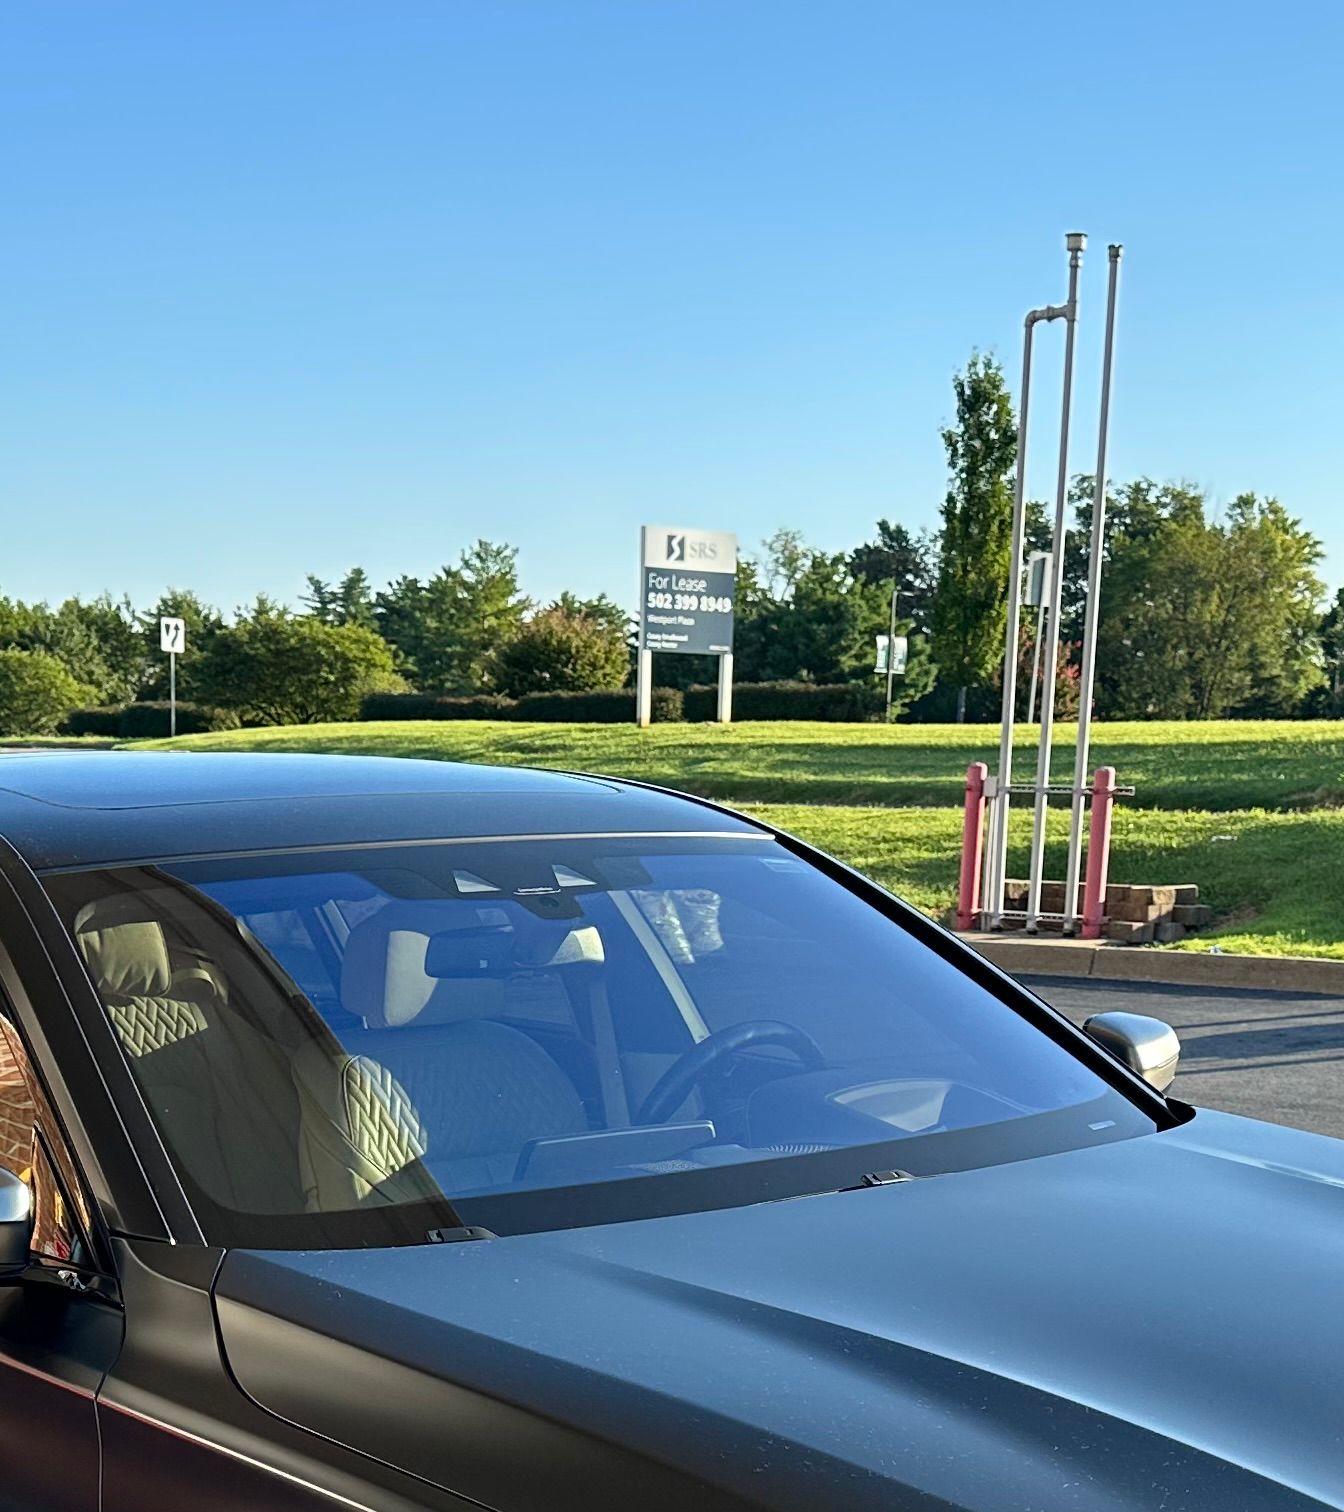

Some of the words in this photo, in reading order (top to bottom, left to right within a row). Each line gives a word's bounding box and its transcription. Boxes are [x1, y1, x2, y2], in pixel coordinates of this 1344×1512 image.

[688, 542, 717, 560] SRS
[648, 572, 669, 590] For
[671, 574, 707, 592] Lease
[647, 592, 673, 609] 502
